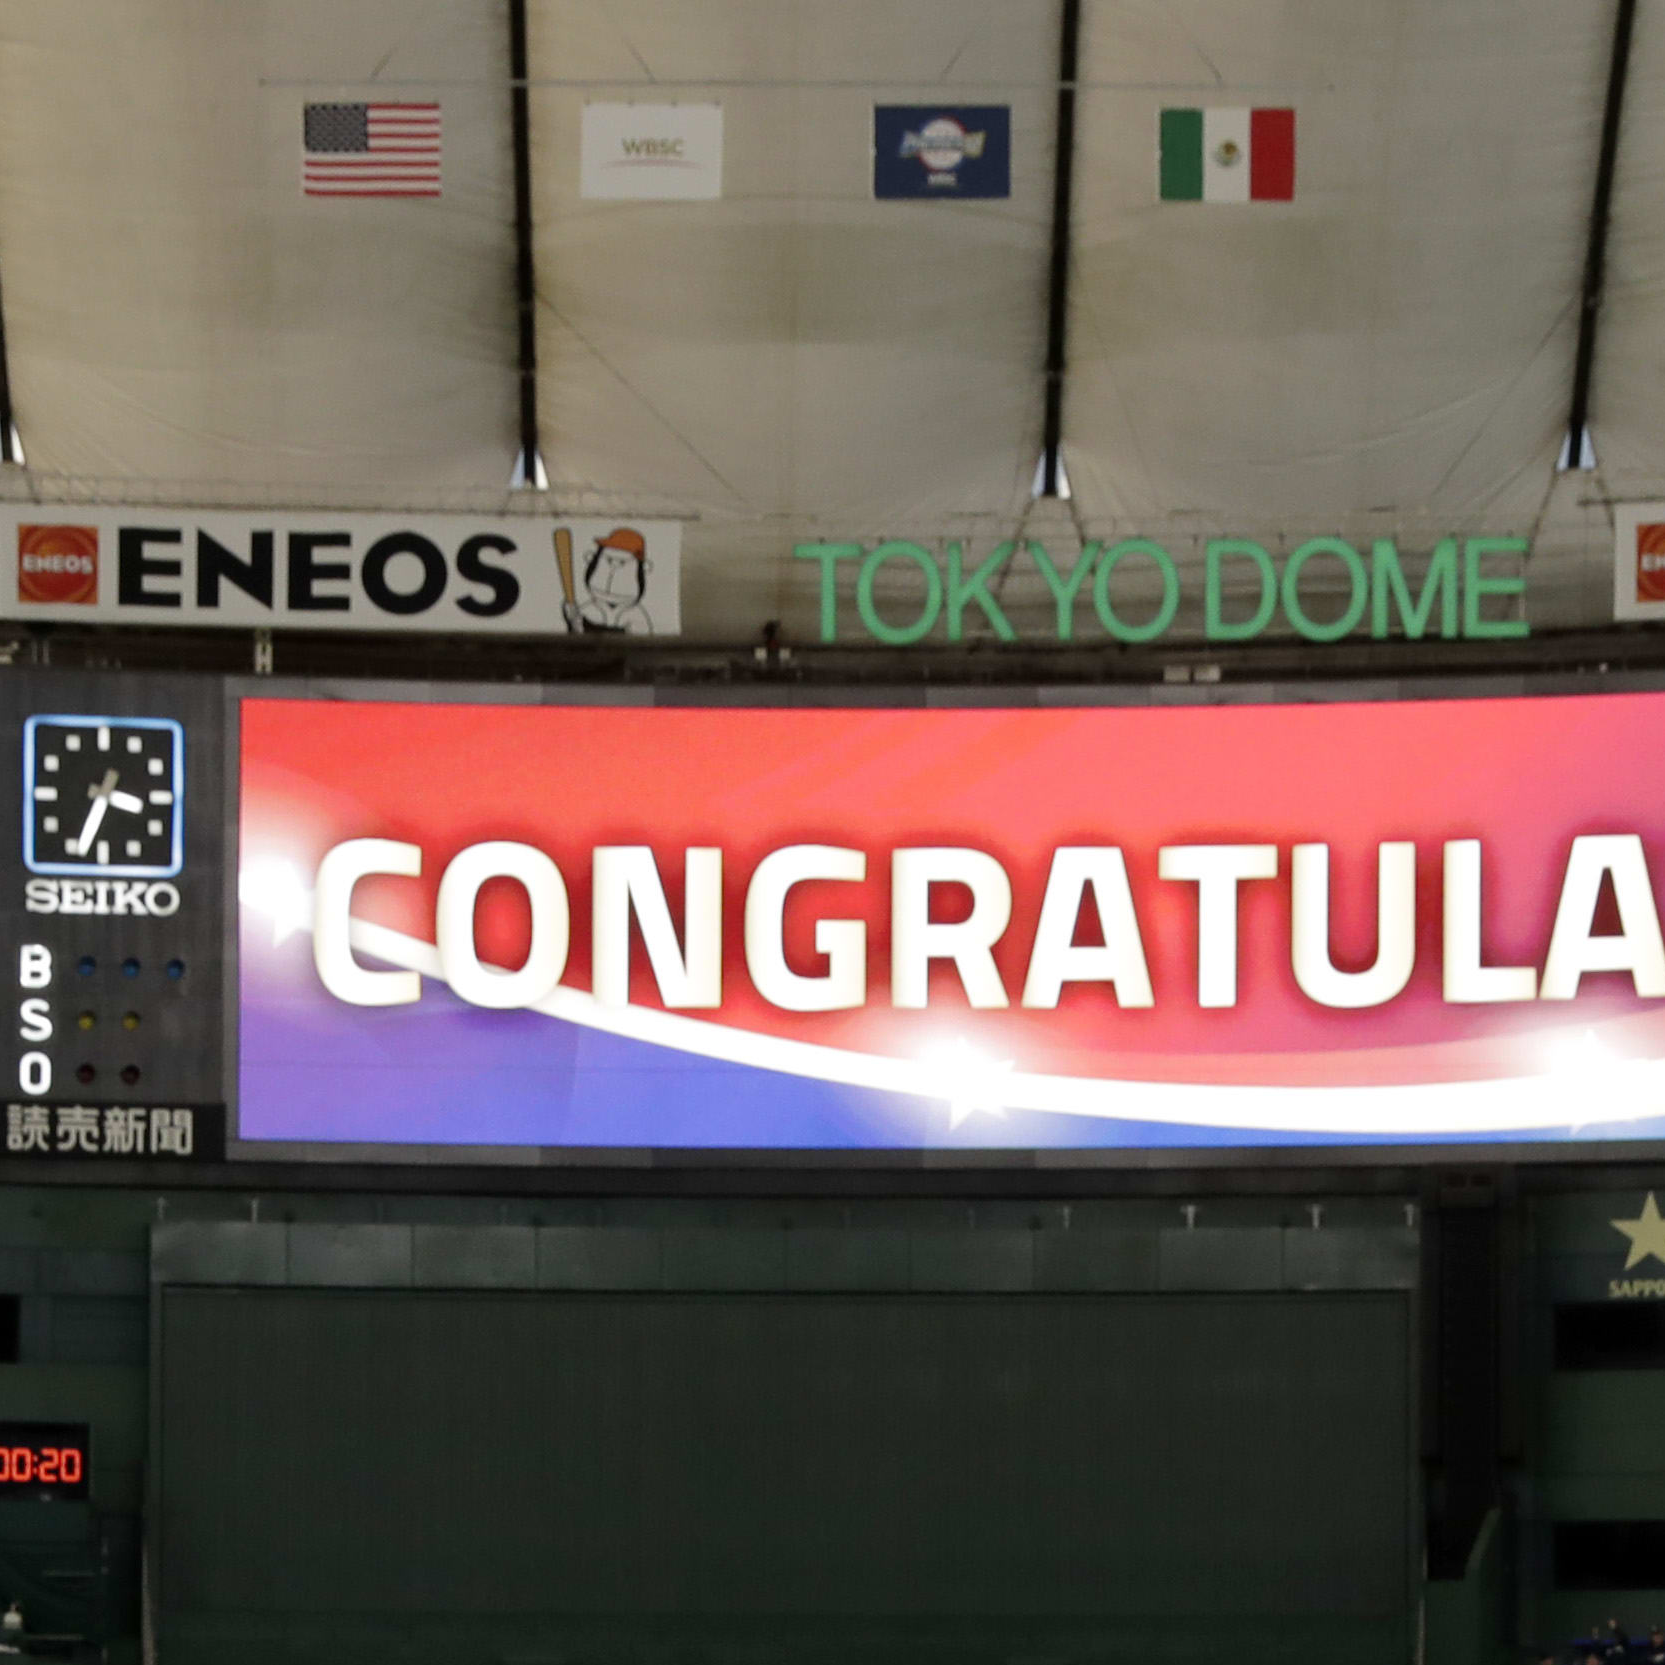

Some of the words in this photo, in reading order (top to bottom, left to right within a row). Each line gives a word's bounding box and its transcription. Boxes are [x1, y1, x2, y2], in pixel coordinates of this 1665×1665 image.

[22, 552, 93, 576] ENEOS
[118, 525, 521, 618] ENEOS
[794, 538, 1180, 643] TOKYO
[1203, 538, 1531, 642] DOME
[26, 879, 179, 916] SEIKO
[19, 943, 53, 989] B
[19, 997, 53, 1041] S
[19, 1051, 53, 1095] O
[6, 1104, 193, 1155] 読売新聞
